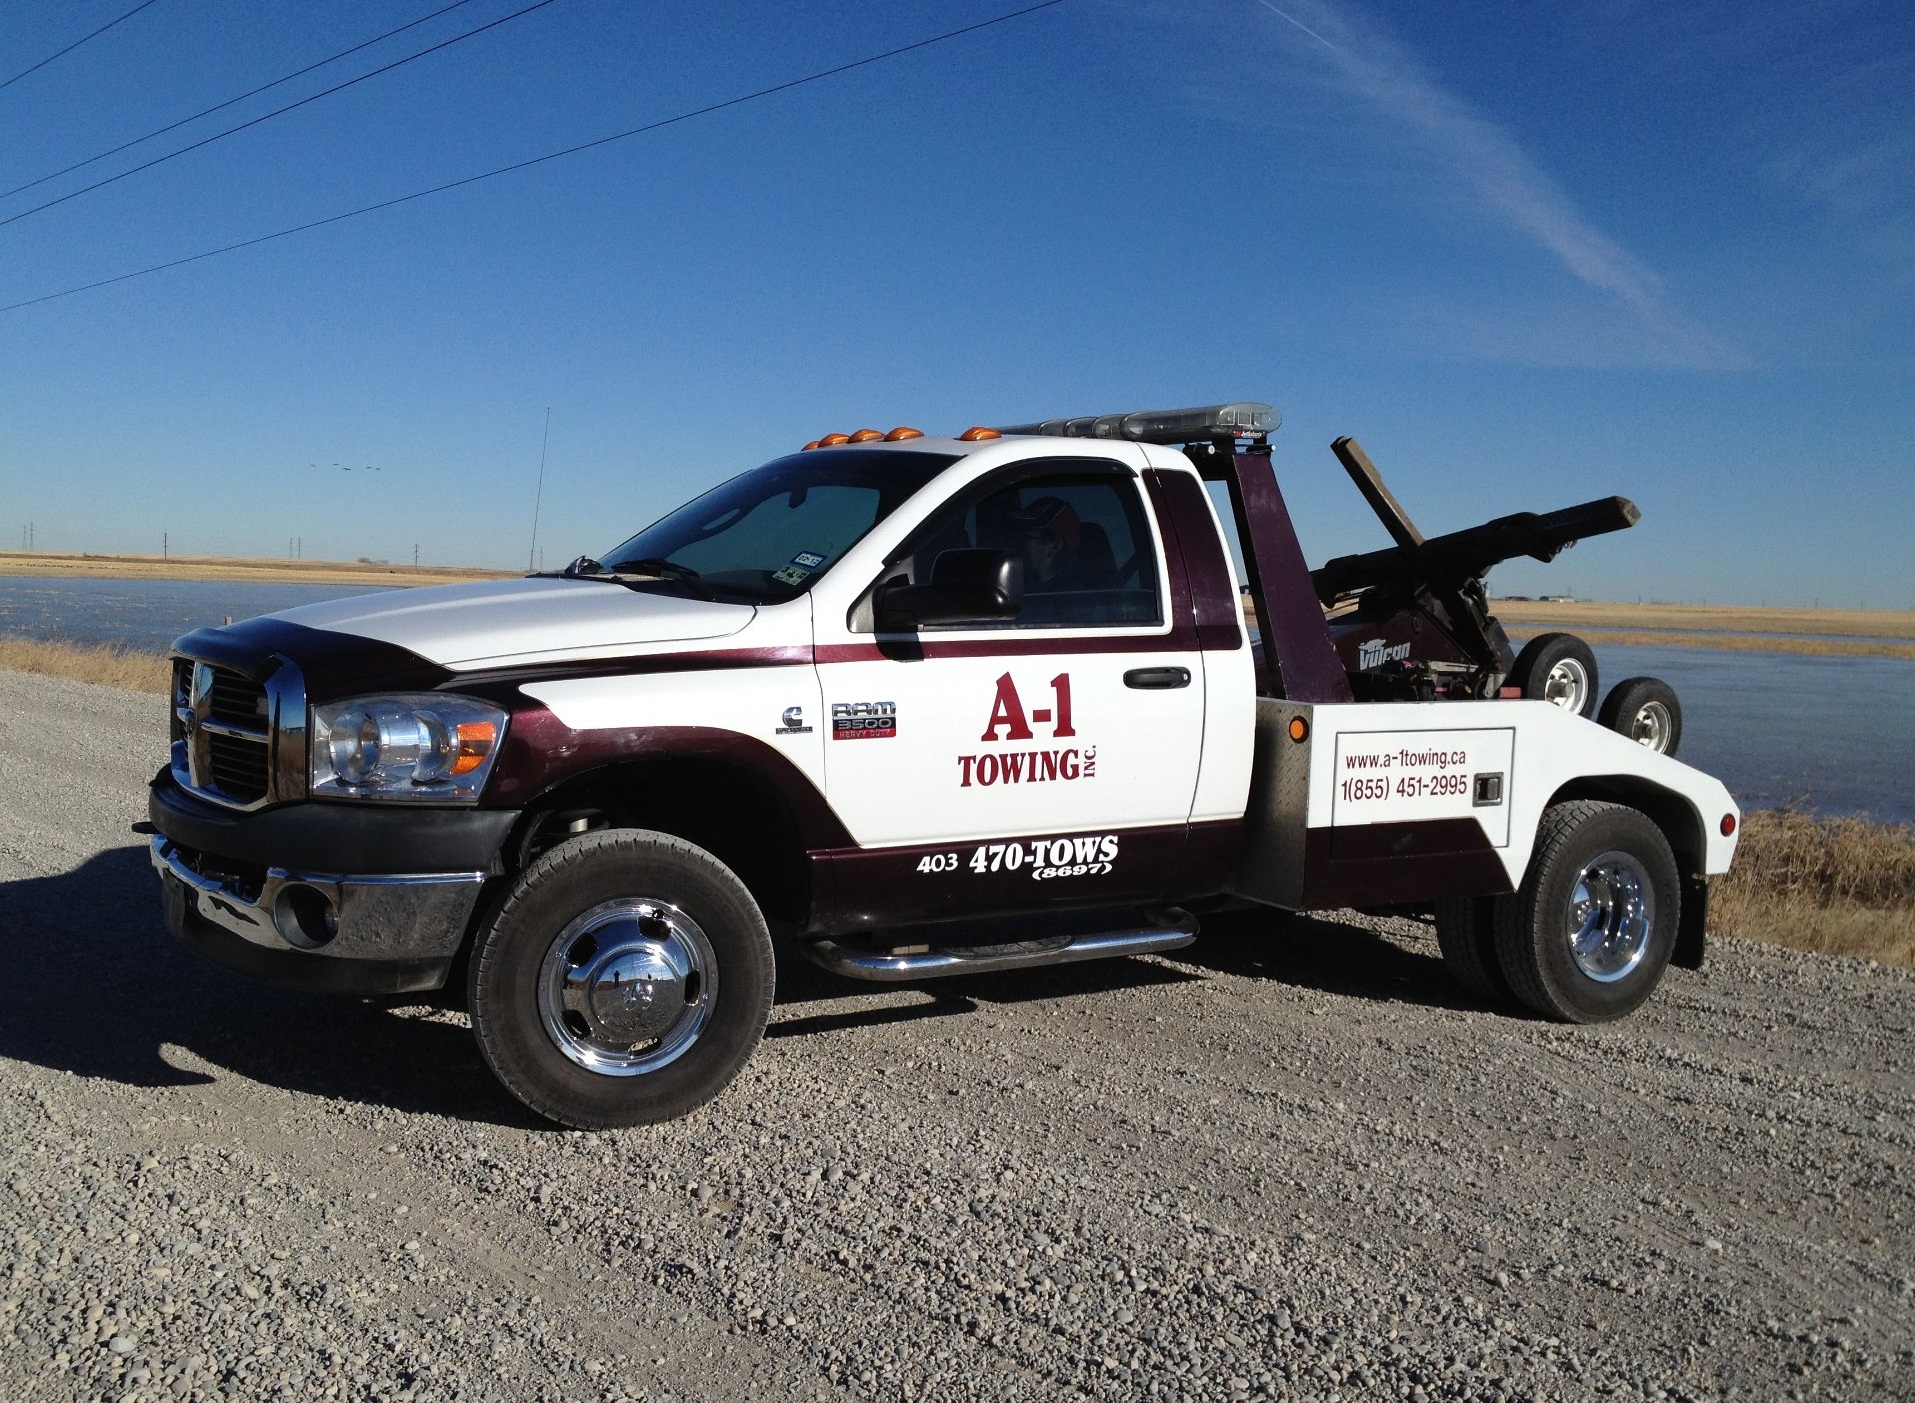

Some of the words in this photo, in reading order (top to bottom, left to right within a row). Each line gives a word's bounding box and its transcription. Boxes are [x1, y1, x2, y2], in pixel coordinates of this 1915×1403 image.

[1360, 642, 1411, 671] Vulcan
[831, 701, 896, 718] RAM
[981, 671, 1075, 741] A-1
[838, 718, 892, 730] 3500
[870, 729, 891, 737] DUTY
[958, 749, 1080, 788] TOWING
[1083, 744, 1097, 778] INC.
[1346, 748, 1466, 769] www.a-1towing.ca
[1341, 776, 1390, 802] 1(855)
[1396, 774, 1468, 798] 451-2995
[916, 853, 958, 873] 403
[969, 835, 1119, 873] 470-TOWS
[1031, 862, 1113, 881] (8697)
